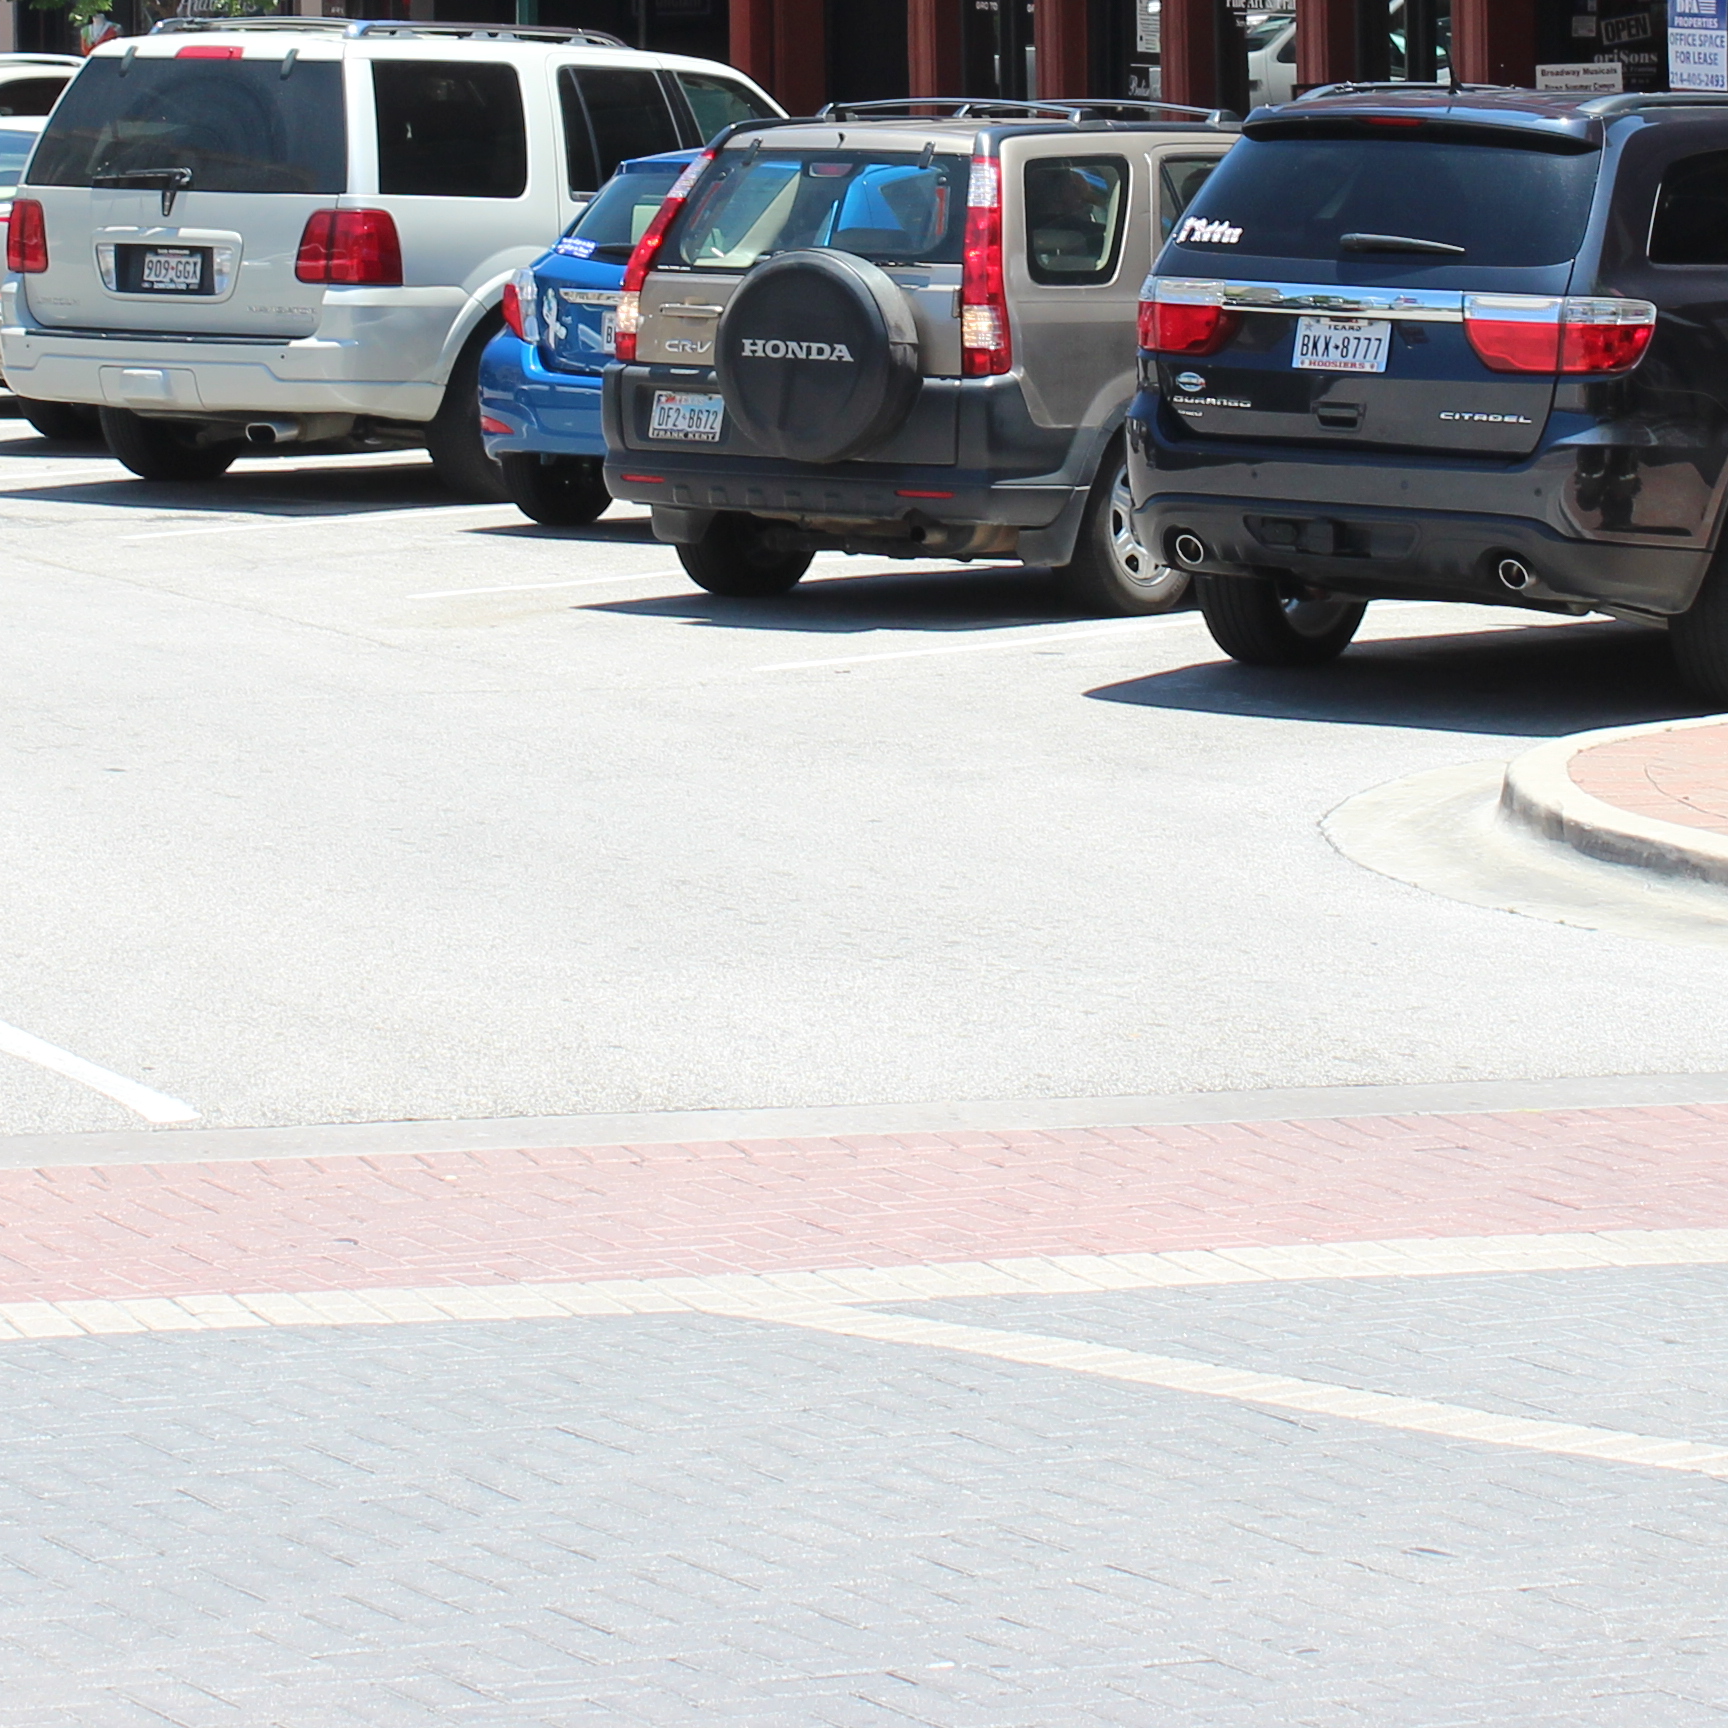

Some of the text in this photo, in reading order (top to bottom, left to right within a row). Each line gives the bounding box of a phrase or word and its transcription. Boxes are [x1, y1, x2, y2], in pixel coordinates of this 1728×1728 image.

[1604, 15, 1648, 42] OPEN
[1674, 16, 1719, 29] PROPERTIES
[1669, 33, 1725, 48] OFFICE SPACE
[1675, 51, 1719, 66] FOR LEASE
[1541, 67, 1617, 77] Broadway Musicals
[665, 339, 713, 354] CR-V
[741, 338, 854, 362] HONDA
[1308, 360, 1365, 370] HOOSIERS
[1173, 395, 1252, 408] DURANGO
[1439, 411, 1532, 424] CITADEL
[653, 429, 716, 440] FRANK KENT
